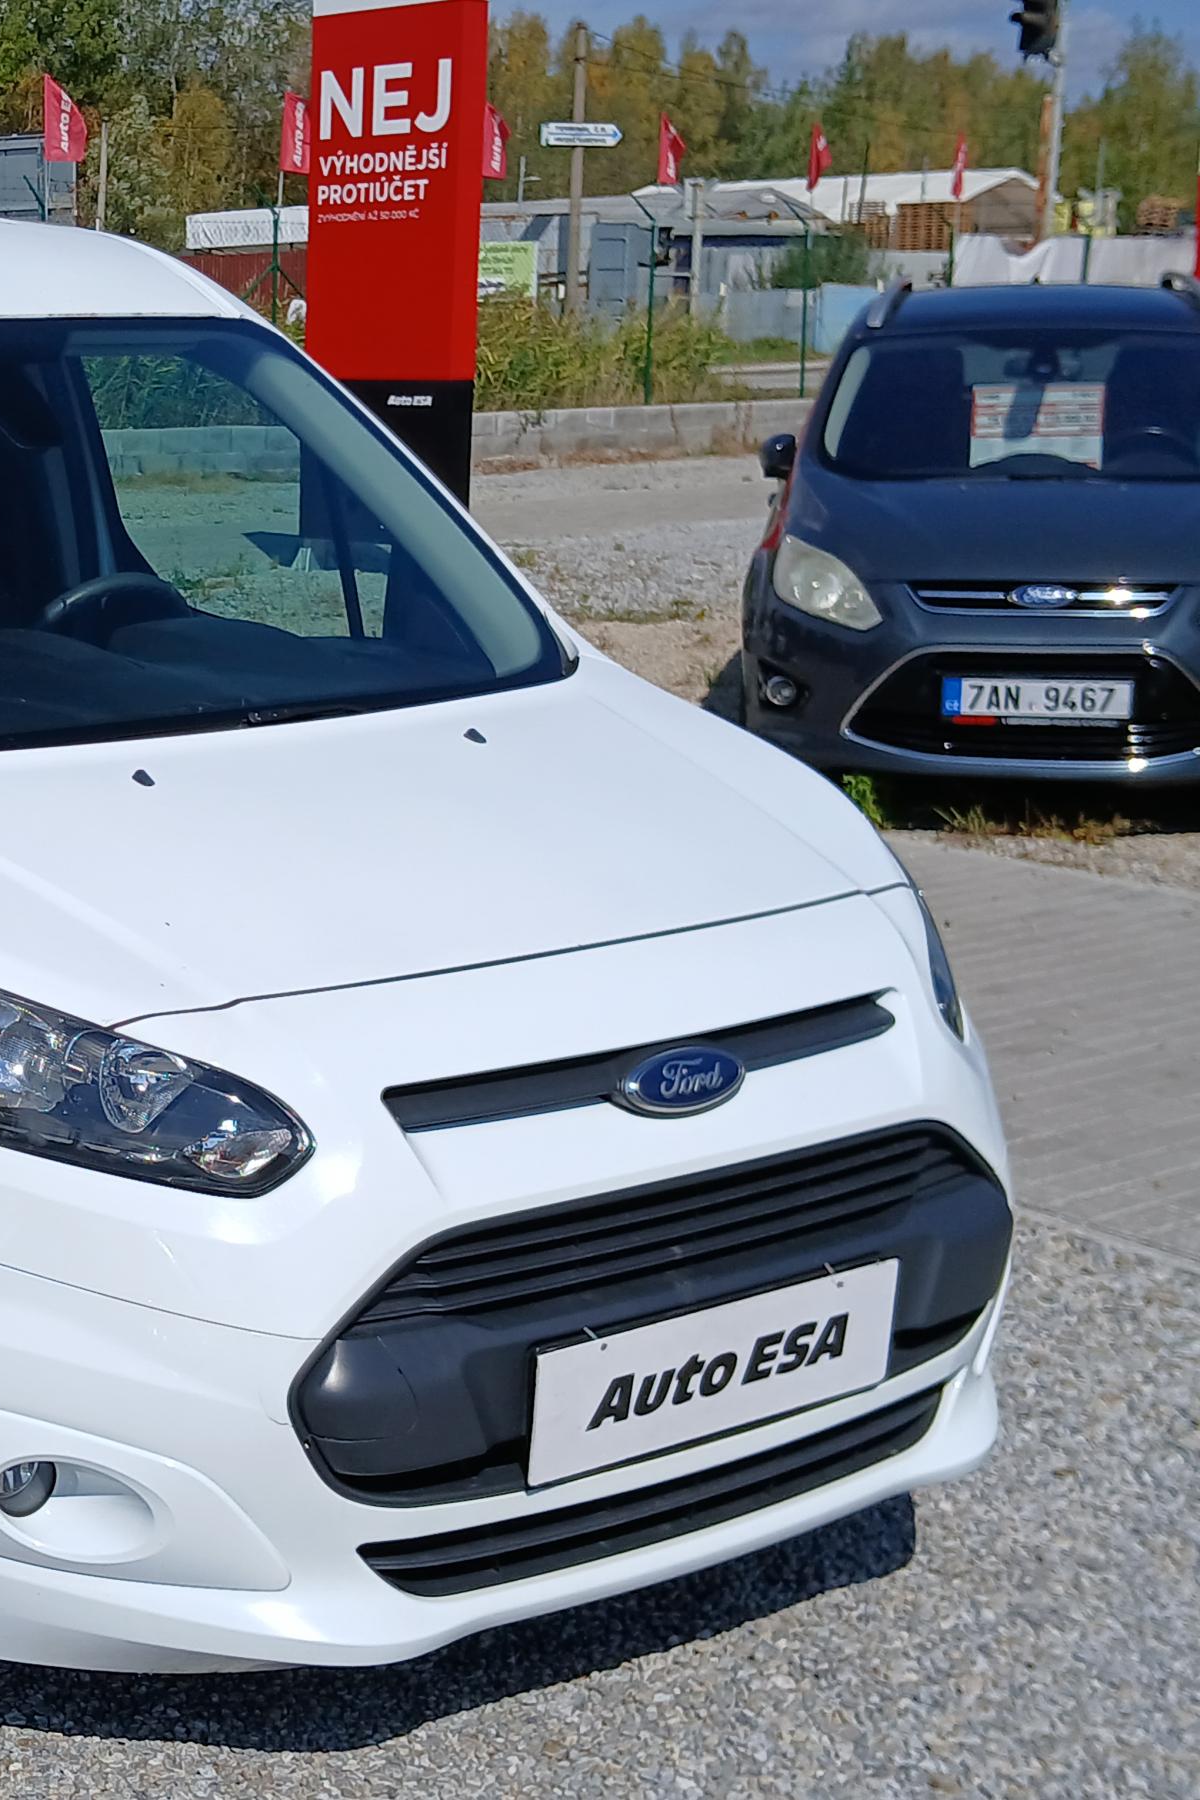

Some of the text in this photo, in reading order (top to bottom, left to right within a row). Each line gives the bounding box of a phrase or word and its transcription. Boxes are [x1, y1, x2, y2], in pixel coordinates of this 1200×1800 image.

[319, 58, 452, 141] NEJ
[59, 112, 70, 153] Auto
[292, 129, 304, 168] Auto
[319, 142, 448, 177] VÝHODNĚJŠÍ
[317, 175, 429, 206] PROTIÚČET
[968, 684, 1115, 712] 7AN 9467
[660, 1058, 724, 1099] Ford
[585, 1311, 850, 1432] Auto ESA
